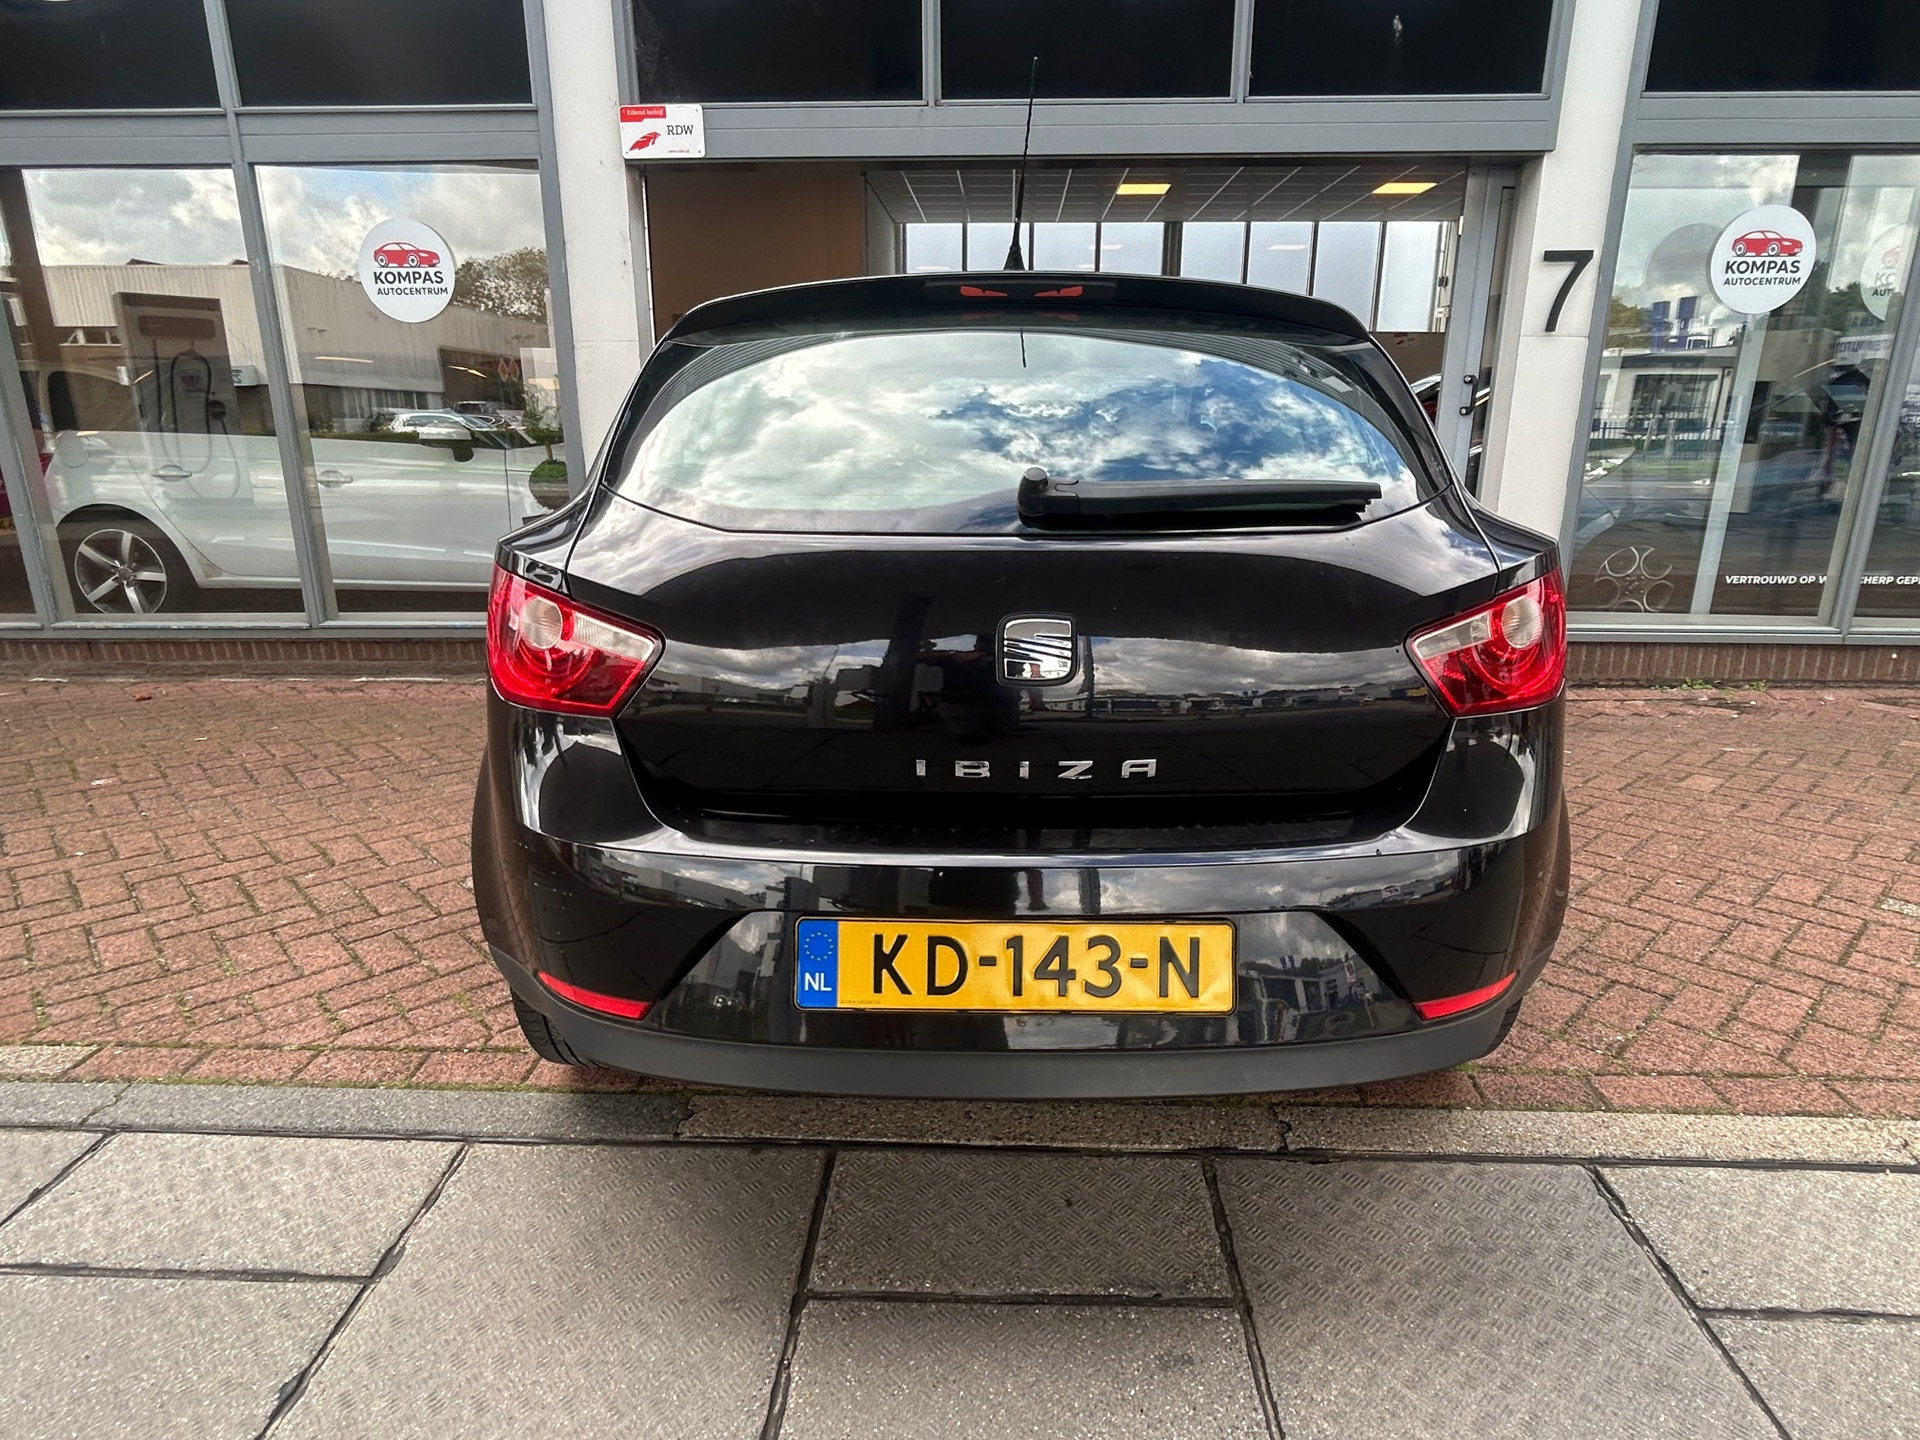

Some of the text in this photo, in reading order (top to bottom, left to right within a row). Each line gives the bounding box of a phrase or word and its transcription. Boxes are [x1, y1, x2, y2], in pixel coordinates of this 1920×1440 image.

[667, 125, 694, 136] RDW
[1725, 260, 1801, 274] KOMPAS
[373, 270, 444, 285] KOMPAS
[1723, 277, 1801, 286] AUTOCENTRUM
[377, 286, 449, 296] AUTOCENTRUM
[1543, 249, 1594, 333] 7
[1725, 575, 1797, 585] VERTROUWD
[1799, 575, 1816, 584] OP
[916, 759, 1157, 779] IBIZA
[872, 933, 1201, 999] KD-143-N
[804, 971, 833, 992] NL
